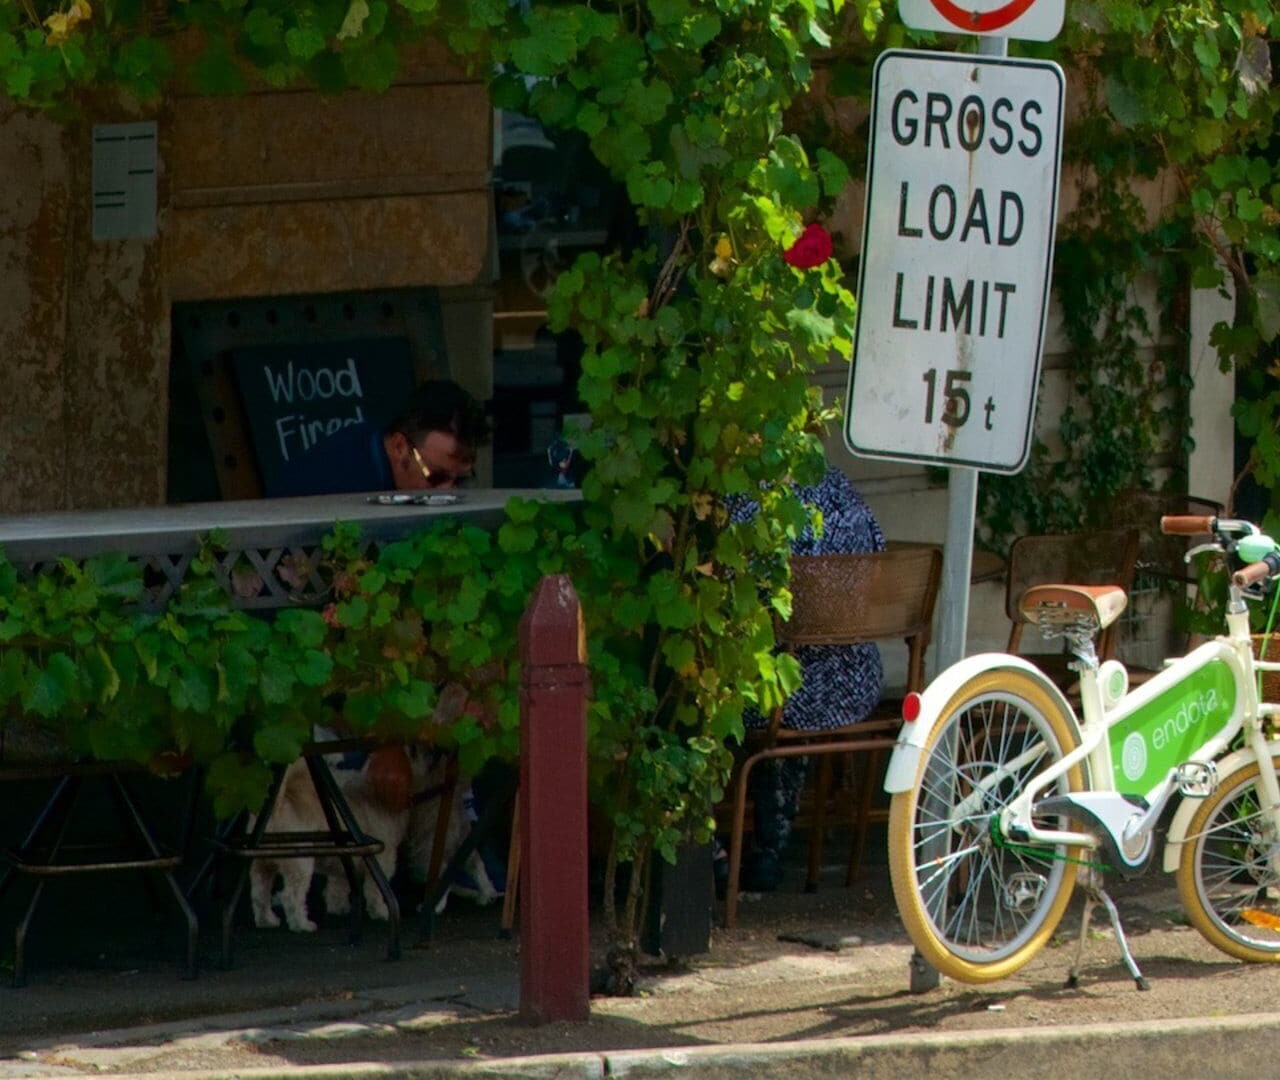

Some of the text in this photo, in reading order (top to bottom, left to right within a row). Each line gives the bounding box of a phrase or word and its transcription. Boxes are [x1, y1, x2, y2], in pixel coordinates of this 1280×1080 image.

[890, 89, 1043, 158] GROSS
[897, 181, 1025, 247] LOAD
[892, 271, 1016, 339] LIMIT
[264, 358, 364, 403] Wood
[922, 367, 996, 431] 15 t
[1152, 688, 1218, 750] endota
